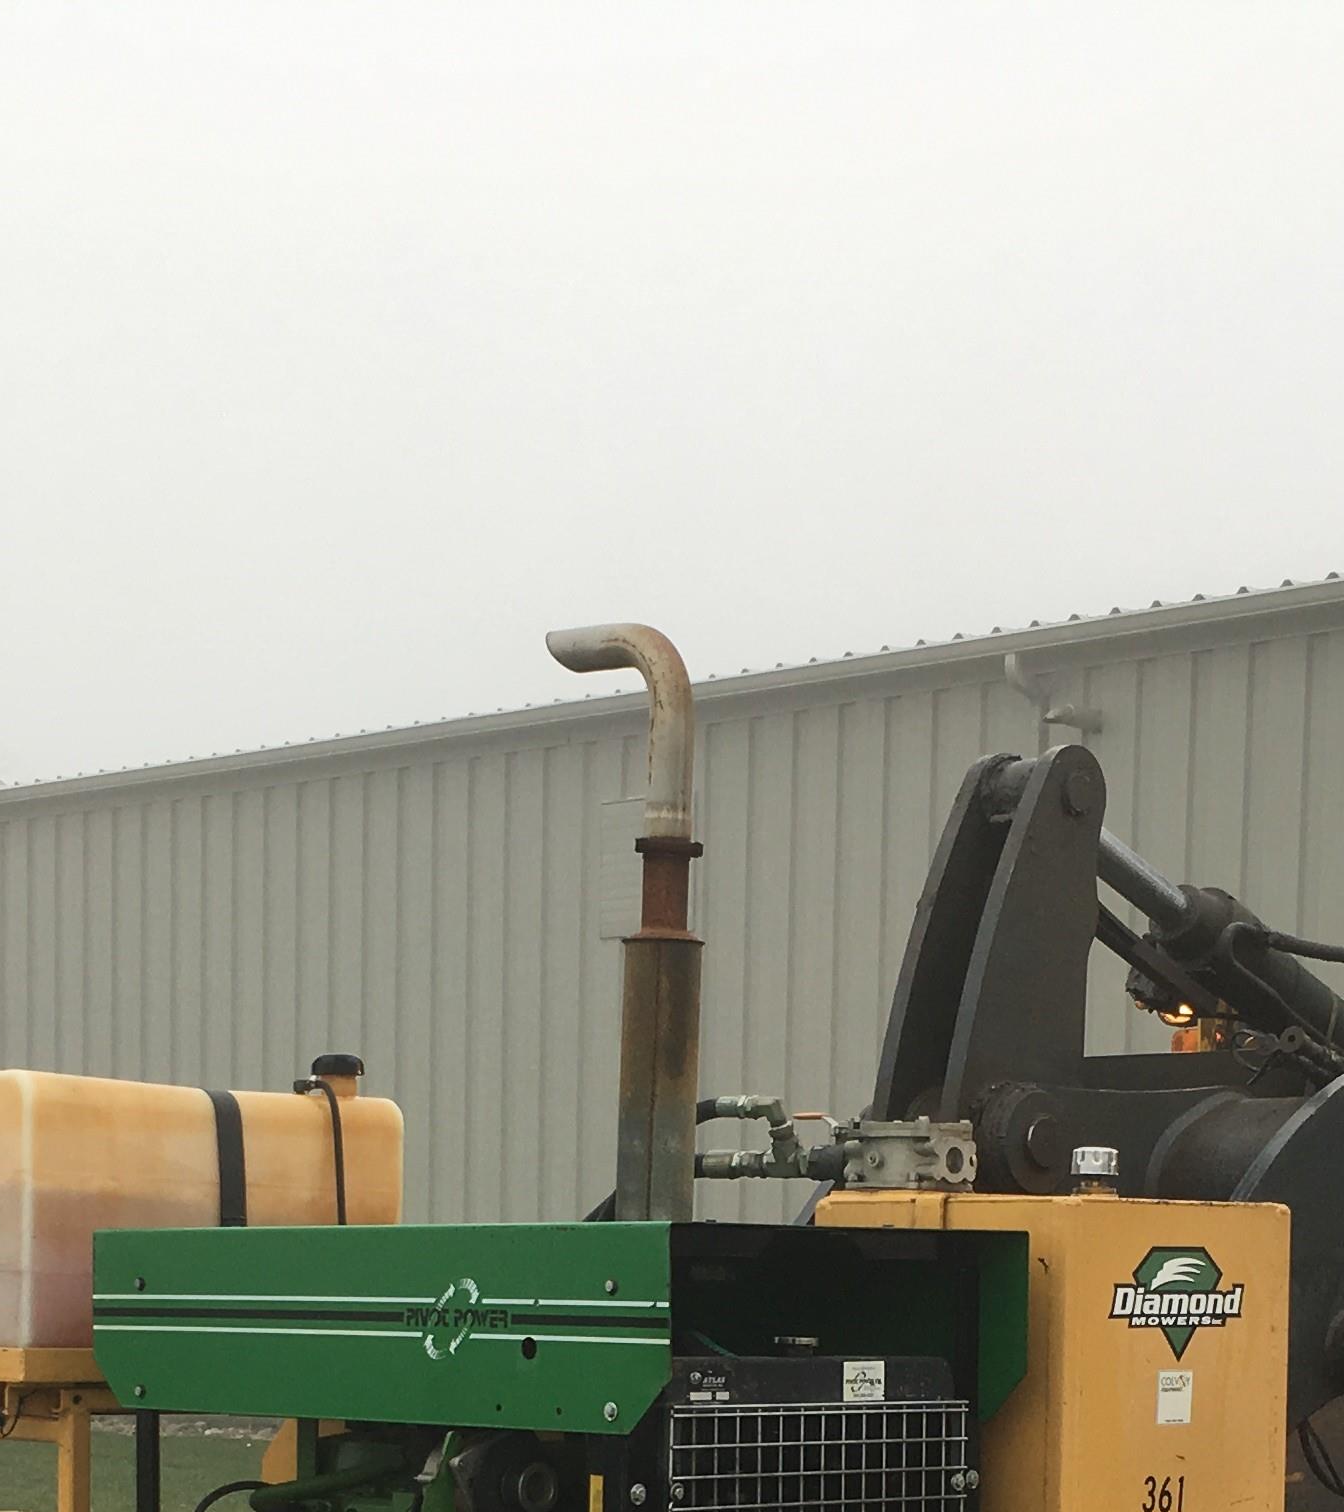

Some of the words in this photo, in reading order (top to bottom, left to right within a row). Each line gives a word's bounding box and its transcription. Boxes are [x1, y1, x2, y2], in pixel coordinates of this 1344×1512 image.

[1112, 1287, 1242, 1316] Diamond
[406, 1307, 449, 1328] PIVOT
[453, 1308, 508, 1329] POWER
[1131, 1316, 1212, 1326] MOWERS
